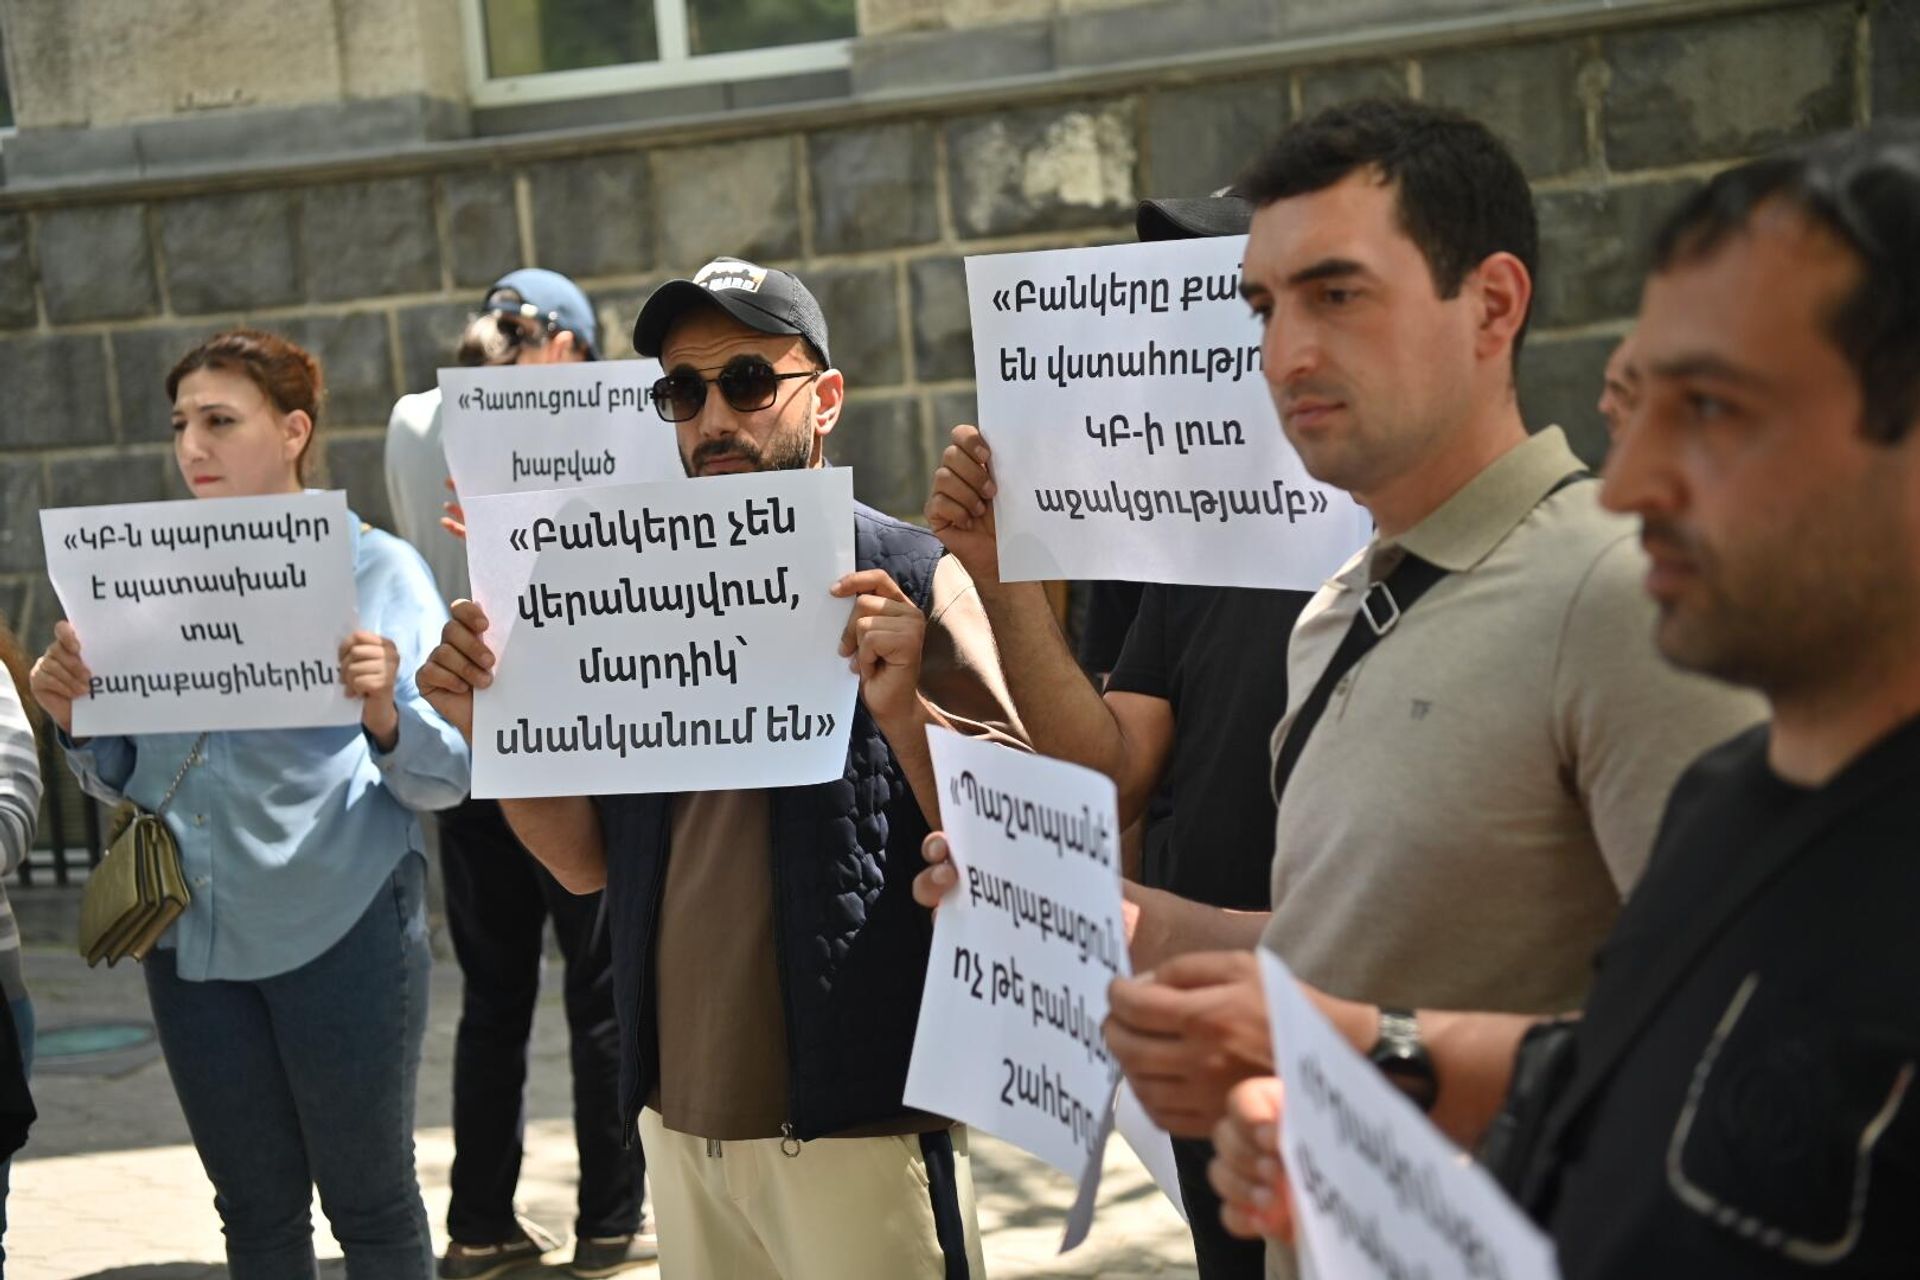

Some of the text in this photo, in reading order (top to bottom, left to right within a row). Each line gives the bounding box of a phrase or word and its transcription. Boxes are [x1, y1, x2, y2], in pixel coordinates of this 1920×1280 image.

[992, 263, 1243, 316] «Բանկերը քա
[1000, 340, 1264, 387] են վստահությո
[459, 381, 667, 415] «Հատուցում բոլո
[1085, 412, 1246, 454] ԿԲ-ի լուռ
[512, 451, 616, 482] խաբված
[1034, 480, 1329, 523] աջակցությամբ»
[64, 513, 330, 550] «ԿԲ-ն պարտավոր
[509, 497, 796, 553] «Բանկերը չեն
[92, 563, 307, 603] է պատասխան
[517, 566, 799, 628] վերանայվում,
[181, 621, 244, 645] տալ
[89, 660, 341, 700] քաղաքացիներին
[496, 704, 836, 758] սնանկանում են»
[950, 770, 1109, 867] «Պաշտպանե
[953, 946, 984, 999] ոչ
[991, 955, 1025, 1008] թե
